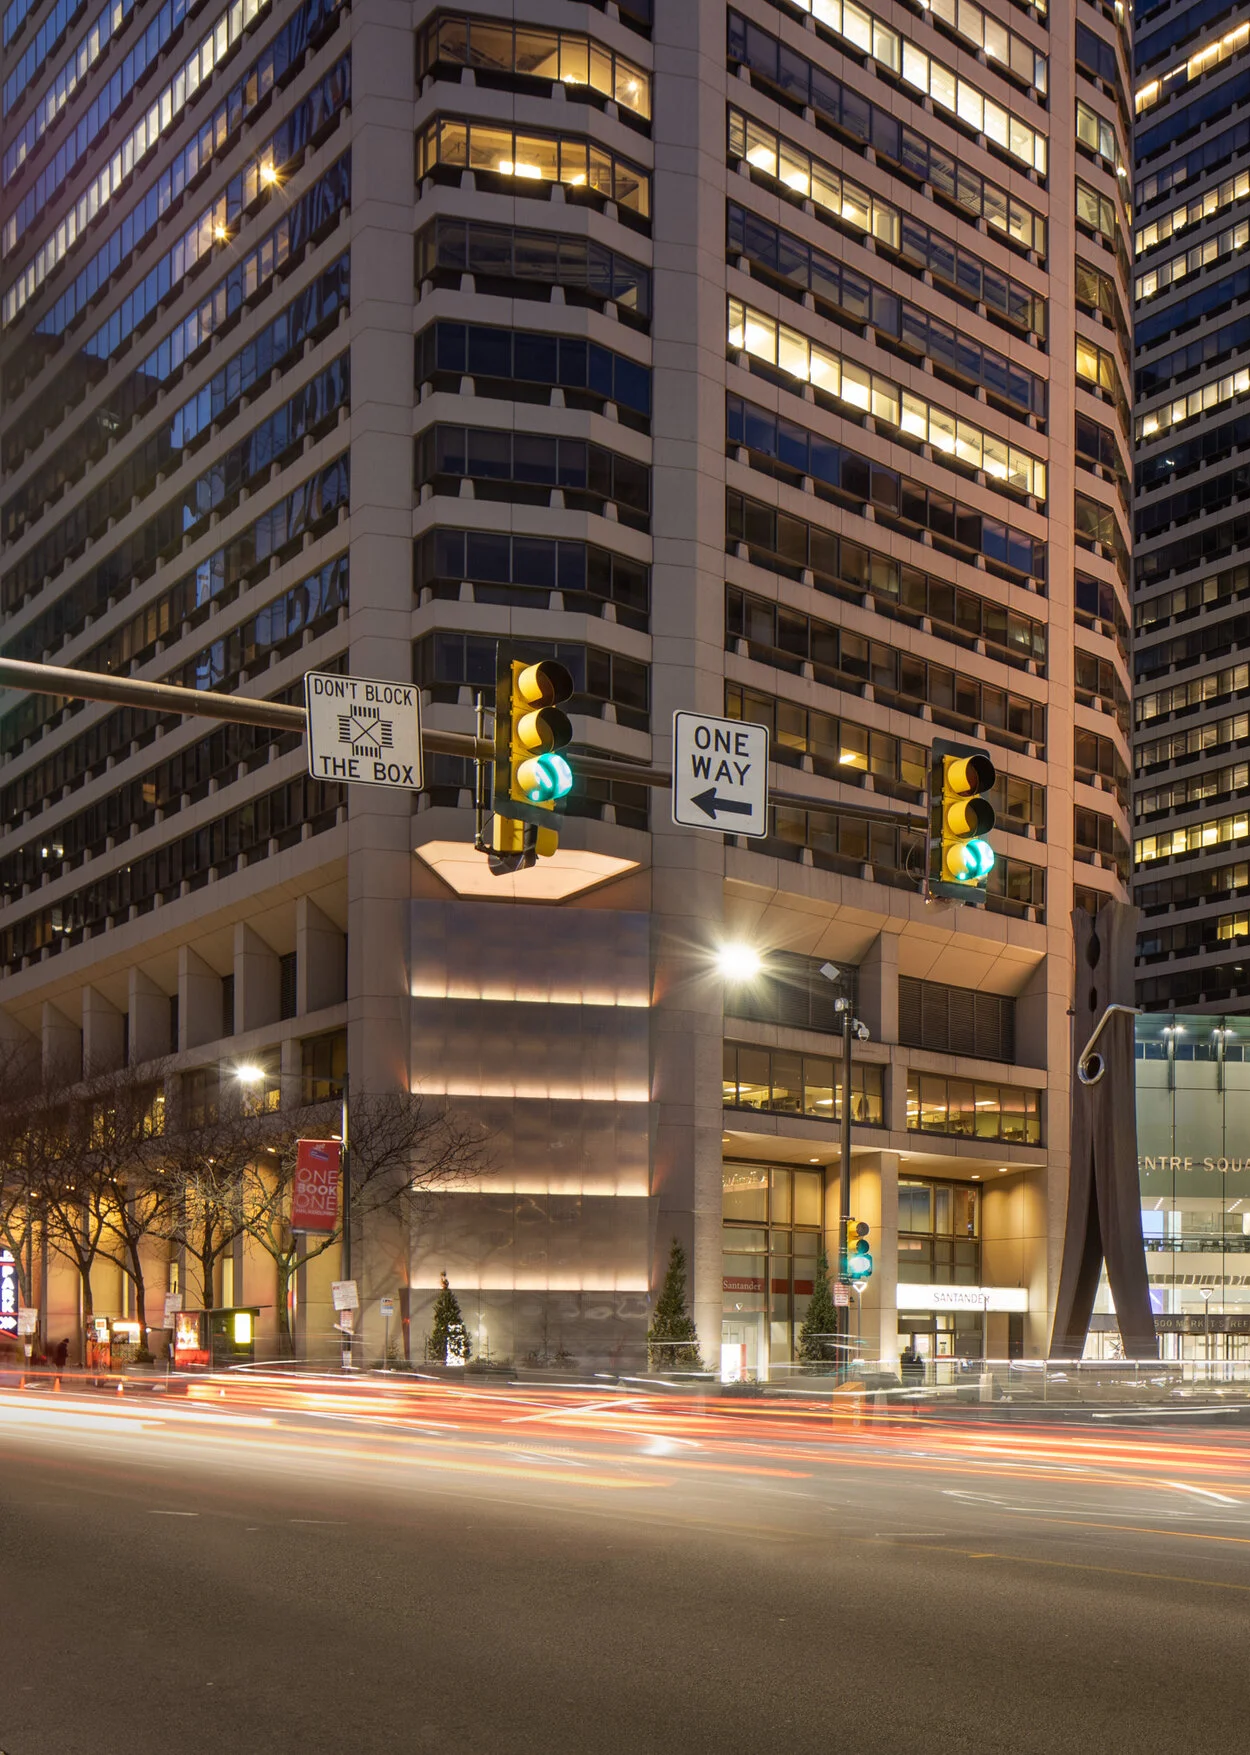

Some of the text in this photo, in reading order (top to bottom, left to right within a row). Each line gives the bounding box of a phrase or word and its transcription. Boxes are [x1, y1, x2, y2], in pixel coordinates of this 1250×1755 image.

[314, 678, 412, 706] DON'T BLOCK
[694, 725, 749, 757] ONE
[319, 755, 414, 784] THE BOX
[691, 754, 751, 786] WAY
[1138, 1156, 1193, 1171] ENTRE
[297, 1168, 339, 1185] ONE
[297, 1182, 337, 1196] BOOK
[295, 1194, 337, 1211] ONE
[1, 1265, 15, 1313] PARK
[723, 1280, 762, 1290] Santander
[933, 1292, 990, 1304] SANTANDER
[1154, 1319, 1172, 1328] 500
